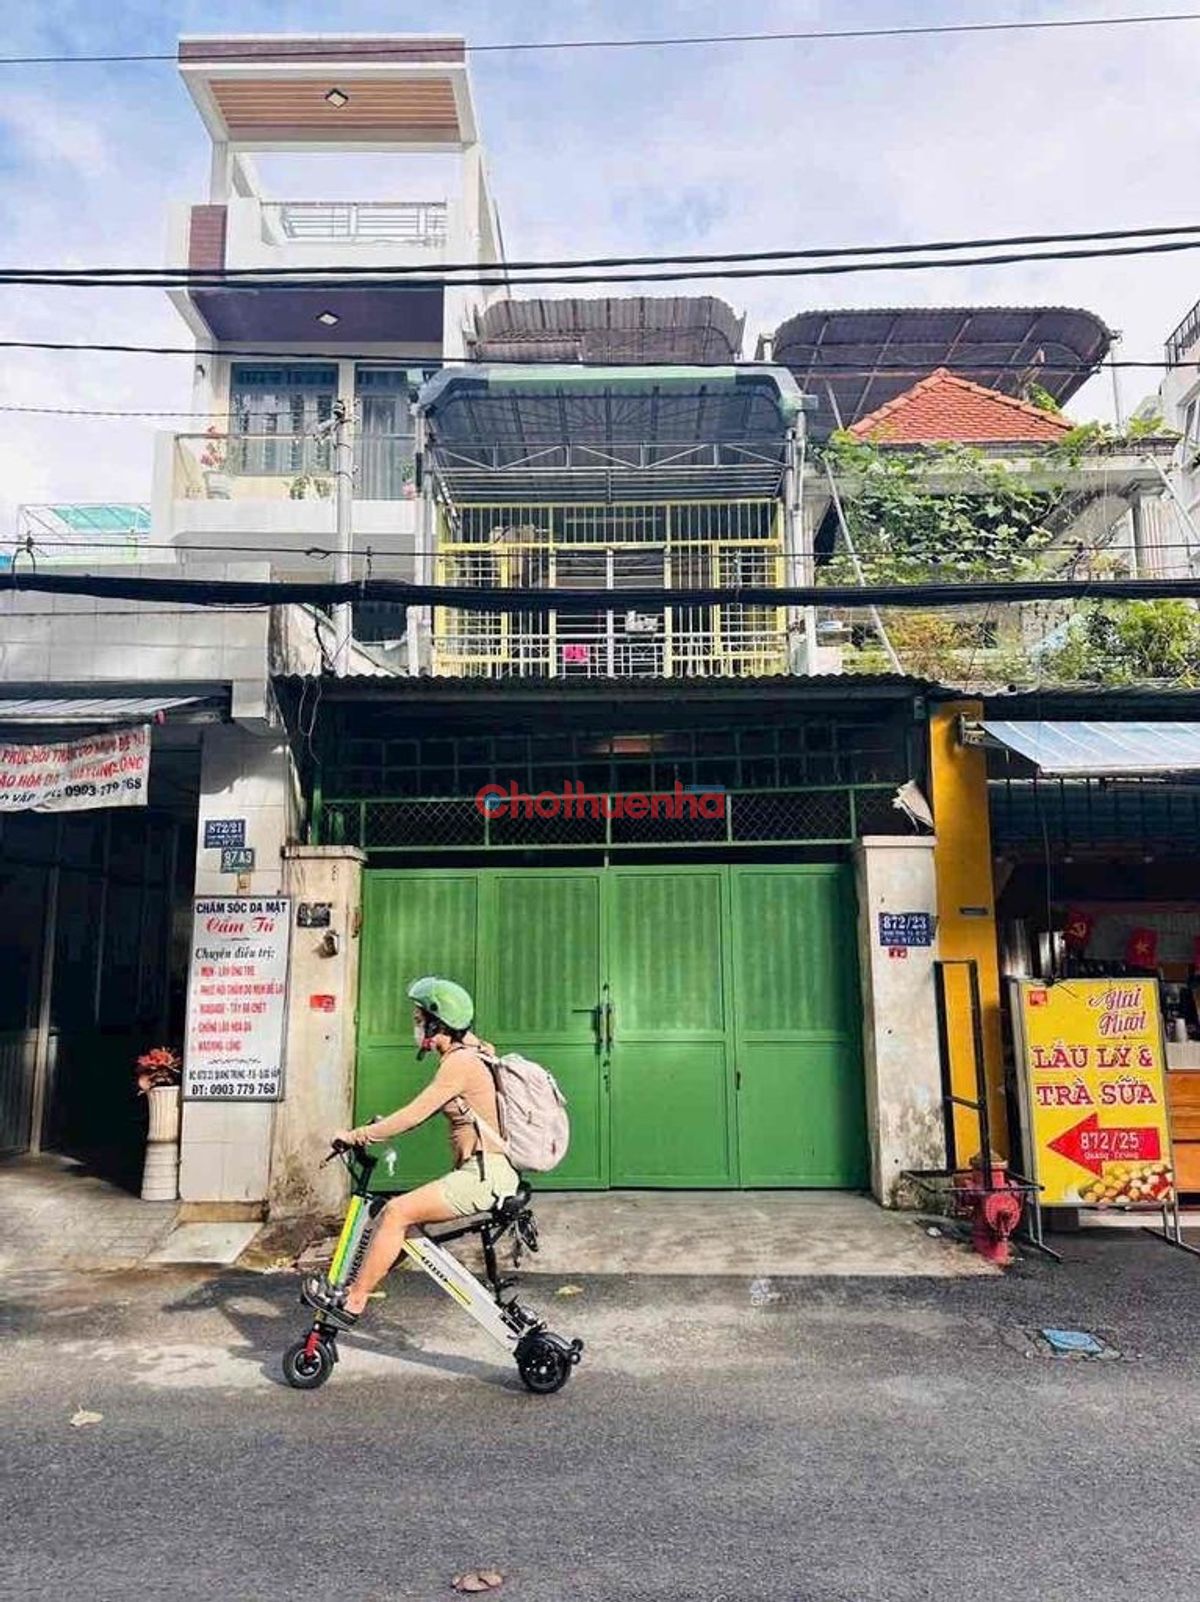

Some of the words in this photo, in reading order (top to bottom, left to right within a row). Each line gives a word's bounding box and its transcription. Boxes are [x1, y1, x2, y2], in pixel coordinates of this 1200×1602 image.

[227, 900, 248, 914] SÓC
[250, 902, 263, 912] DA
[883, 915, 927, 930] 872/23
[1138, 1046, 1153, 1067] &
[192, 1084, 208, 1096] ĐT:
[210, 1083, 235, 1096] 0903
[237, 1082, 255, 1095] 779
[258, 1082, 276, 1095] 768
[1036, 1077, 1094, 1106] TRÀ
[1101, 1075, 1157, 1105] SỮA
[1080, 1131, 1140, 1151] 872/25
